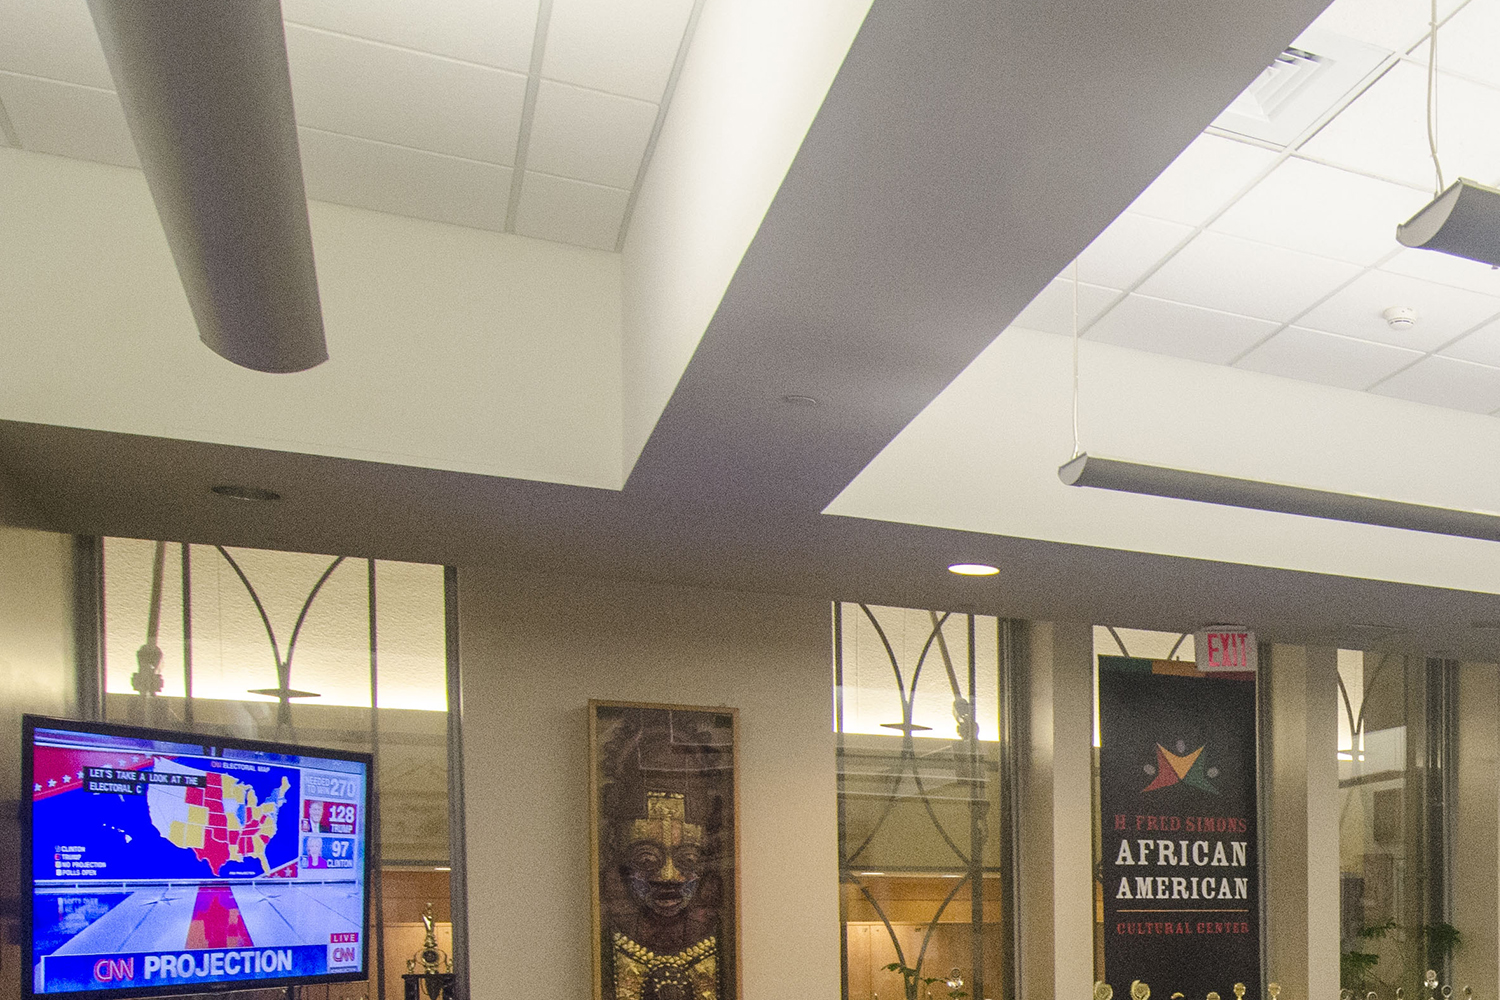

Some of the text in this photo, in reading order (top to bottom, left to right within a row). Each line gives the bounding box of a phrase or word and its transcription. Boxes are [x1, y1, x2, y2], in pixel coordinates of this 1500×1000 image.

[1207, 633, 1247, 667] EXIT
[90, 769, 198, 785] LET'S TAKE A LOOK AT THE
[90, 782, 142, 793] ELECTORAL C
[331, 778, 356, 798] 270
[329, 805, 355, 823] 128
[331, 824, 353, 833] TRUMP
[1136, 815, 1180, 831] FRED
[1185, 816, 1247, 832] SIMONS
[331, 841, 350, 857] 97
[1115, 839, 1247, 867] AFRICAN
[327, 859, 353, 867] CLINTON
[1116, 877, 1248, 899] AMERICAN
[1117, 922, 1249, 934] CULTURAL CENTER
[333, 933, 356, 942] LIVE
[332, 947, 356, 962] CNN
[94, 950, 293, 982] CNN PROJECTION
